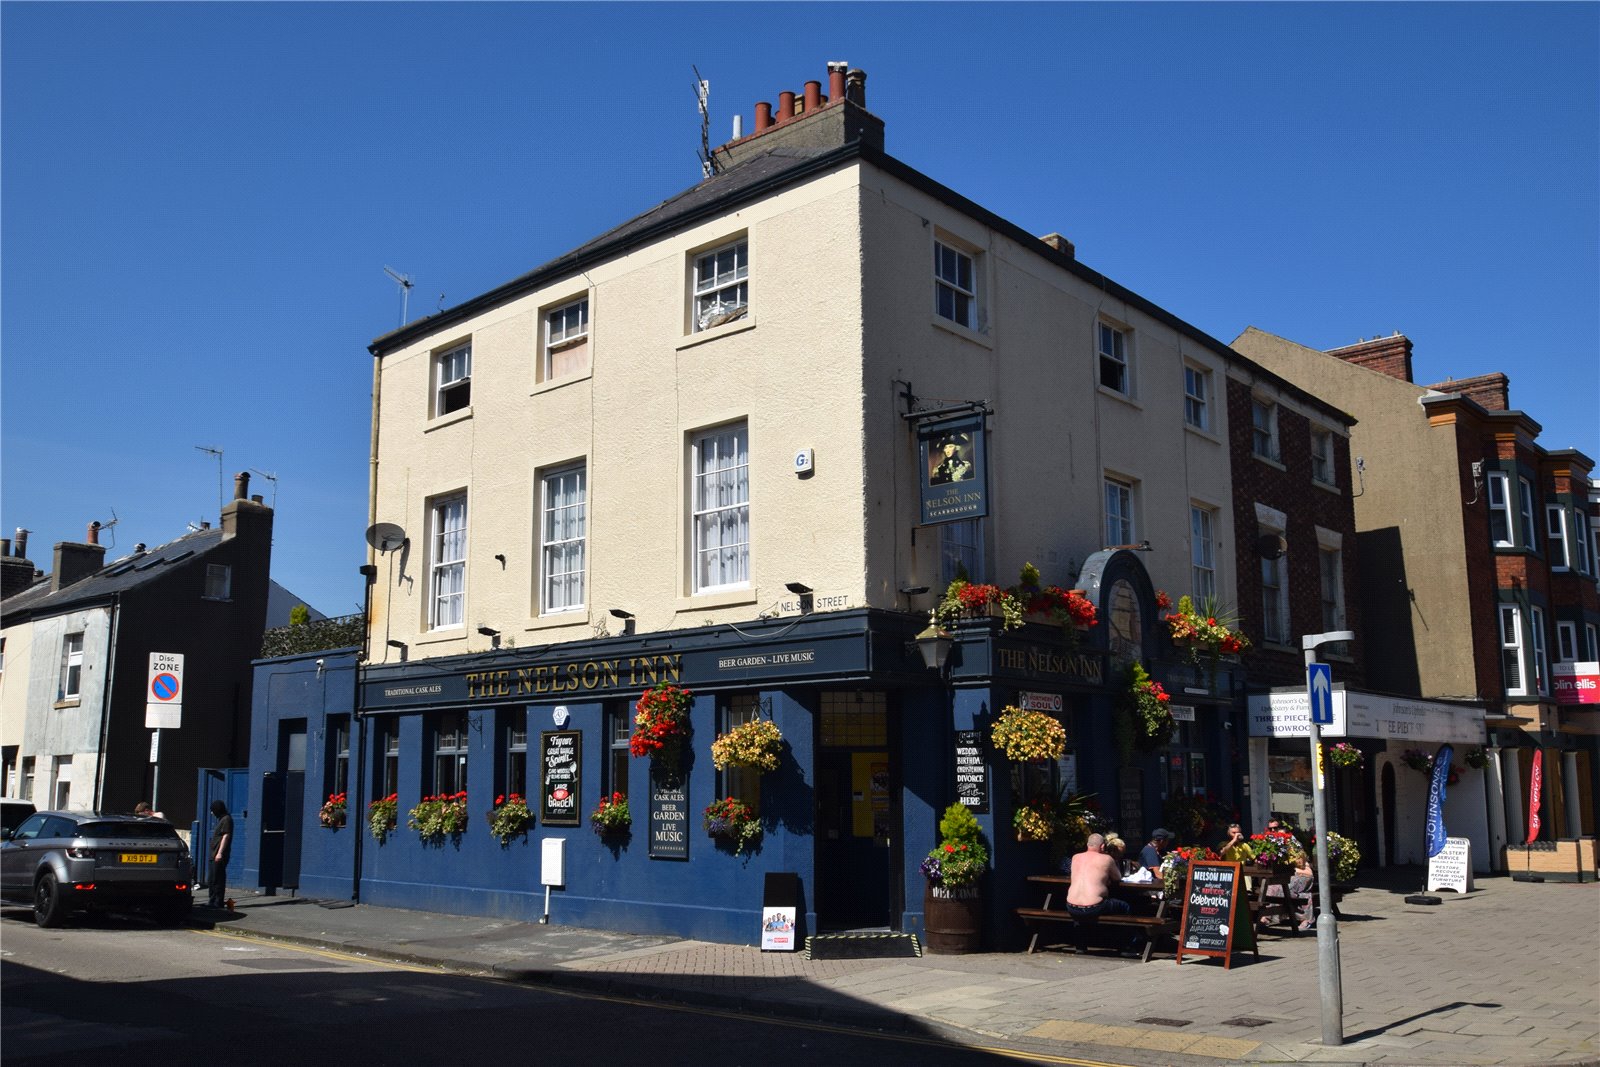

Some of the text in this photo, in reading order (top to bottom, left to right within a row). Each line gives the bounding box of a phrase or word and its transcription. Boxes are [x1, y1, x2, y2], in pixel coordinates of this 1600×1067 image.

[946, 488, 960, 496] THE
[926, 492, 981, 509] NELSON INN
[929, 504, 977, 517] SCARBOROUGH
[780, 595, 848, 612] NELSON STREET
[158, 655, 175, 663] Disc
[718, 658, 737, 669] BEER
[737, 656, 766, 667] GARDEN
[773, 654, 790, 664] LIVE
[790, 651, 815, 663] MUSIC
[997, 648, 1102, 680] THE NELSON INN
[153, 661, 180, 672] ZONE
[467, 653, 682, 698] THE NELSON INN
[1554, 678, 1597, 690] olin ellis
[384, 684, 442, 697] TRADITIONAL CASK ALES
[1030, 701, 1053, 710] SOUL
[1255, 714, 1308, 723] THREE PIECE
[957, 747, 983, 756] WEDDING
[957, 756, 985, 765] BIRTHDAY
[957, 774, 984, 783] DIVORCE
[548, 794, 574, 808] GARDEN
[960, 796, 981, 806] HERE
[1427, 766, 1442, 841] JOHNSONS
[653, 811, 685, 821] GARDEN
[662, 823, 677, 831] LIVE
[655, 831, 683, 842] MUSIC
[1194, 872, 1233, 882] NELSON INN
[1190, 894, 1228, 907] Celebration
[1192, 917, 1222, 925] CATERING
